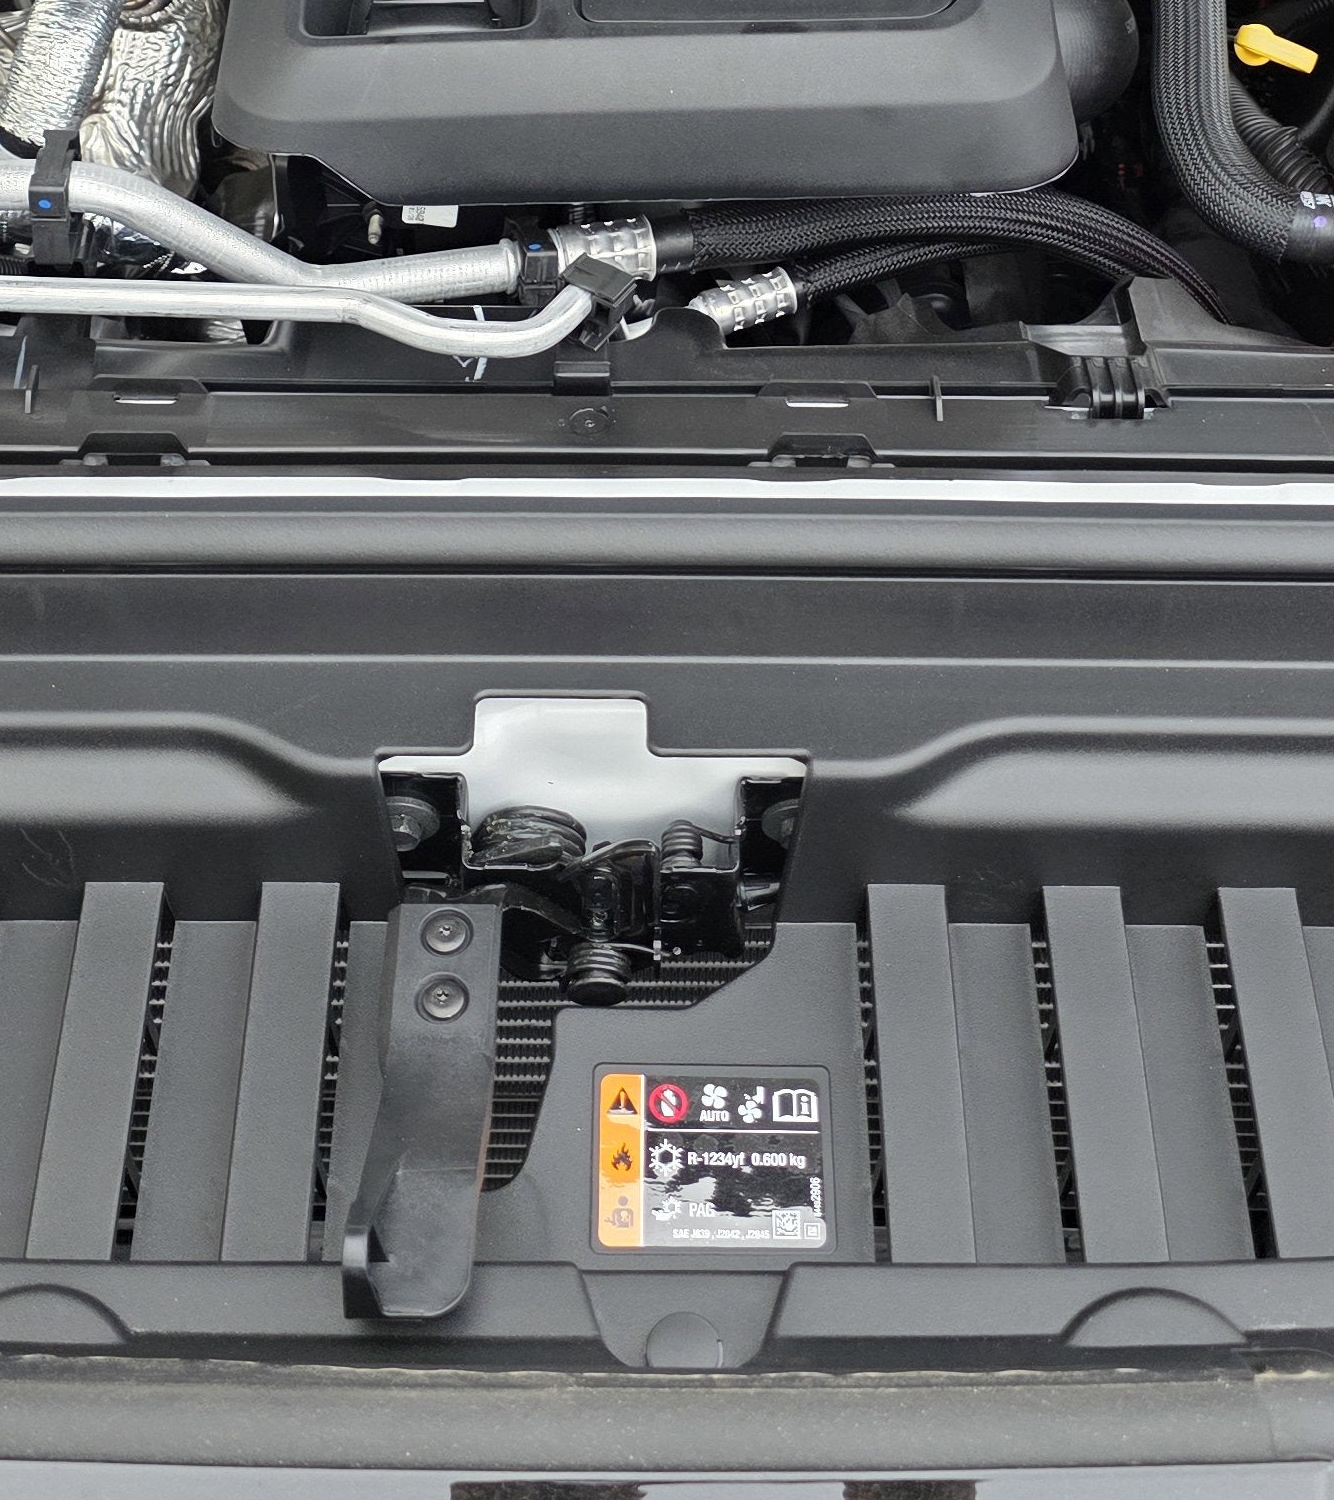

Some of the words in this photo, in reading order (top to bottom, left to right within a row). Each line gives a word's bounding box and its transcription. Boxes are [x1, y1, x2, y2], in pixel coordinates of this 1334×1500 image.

[699, 1109, 730, 1122] AUTO
[687, 1152, 744, 1168] R-1234yf
[751, 1152, 787, 1167] 0.600
[789, 1152, 806, 1169] kg
[689, 1202, 716, 1218] PAG
